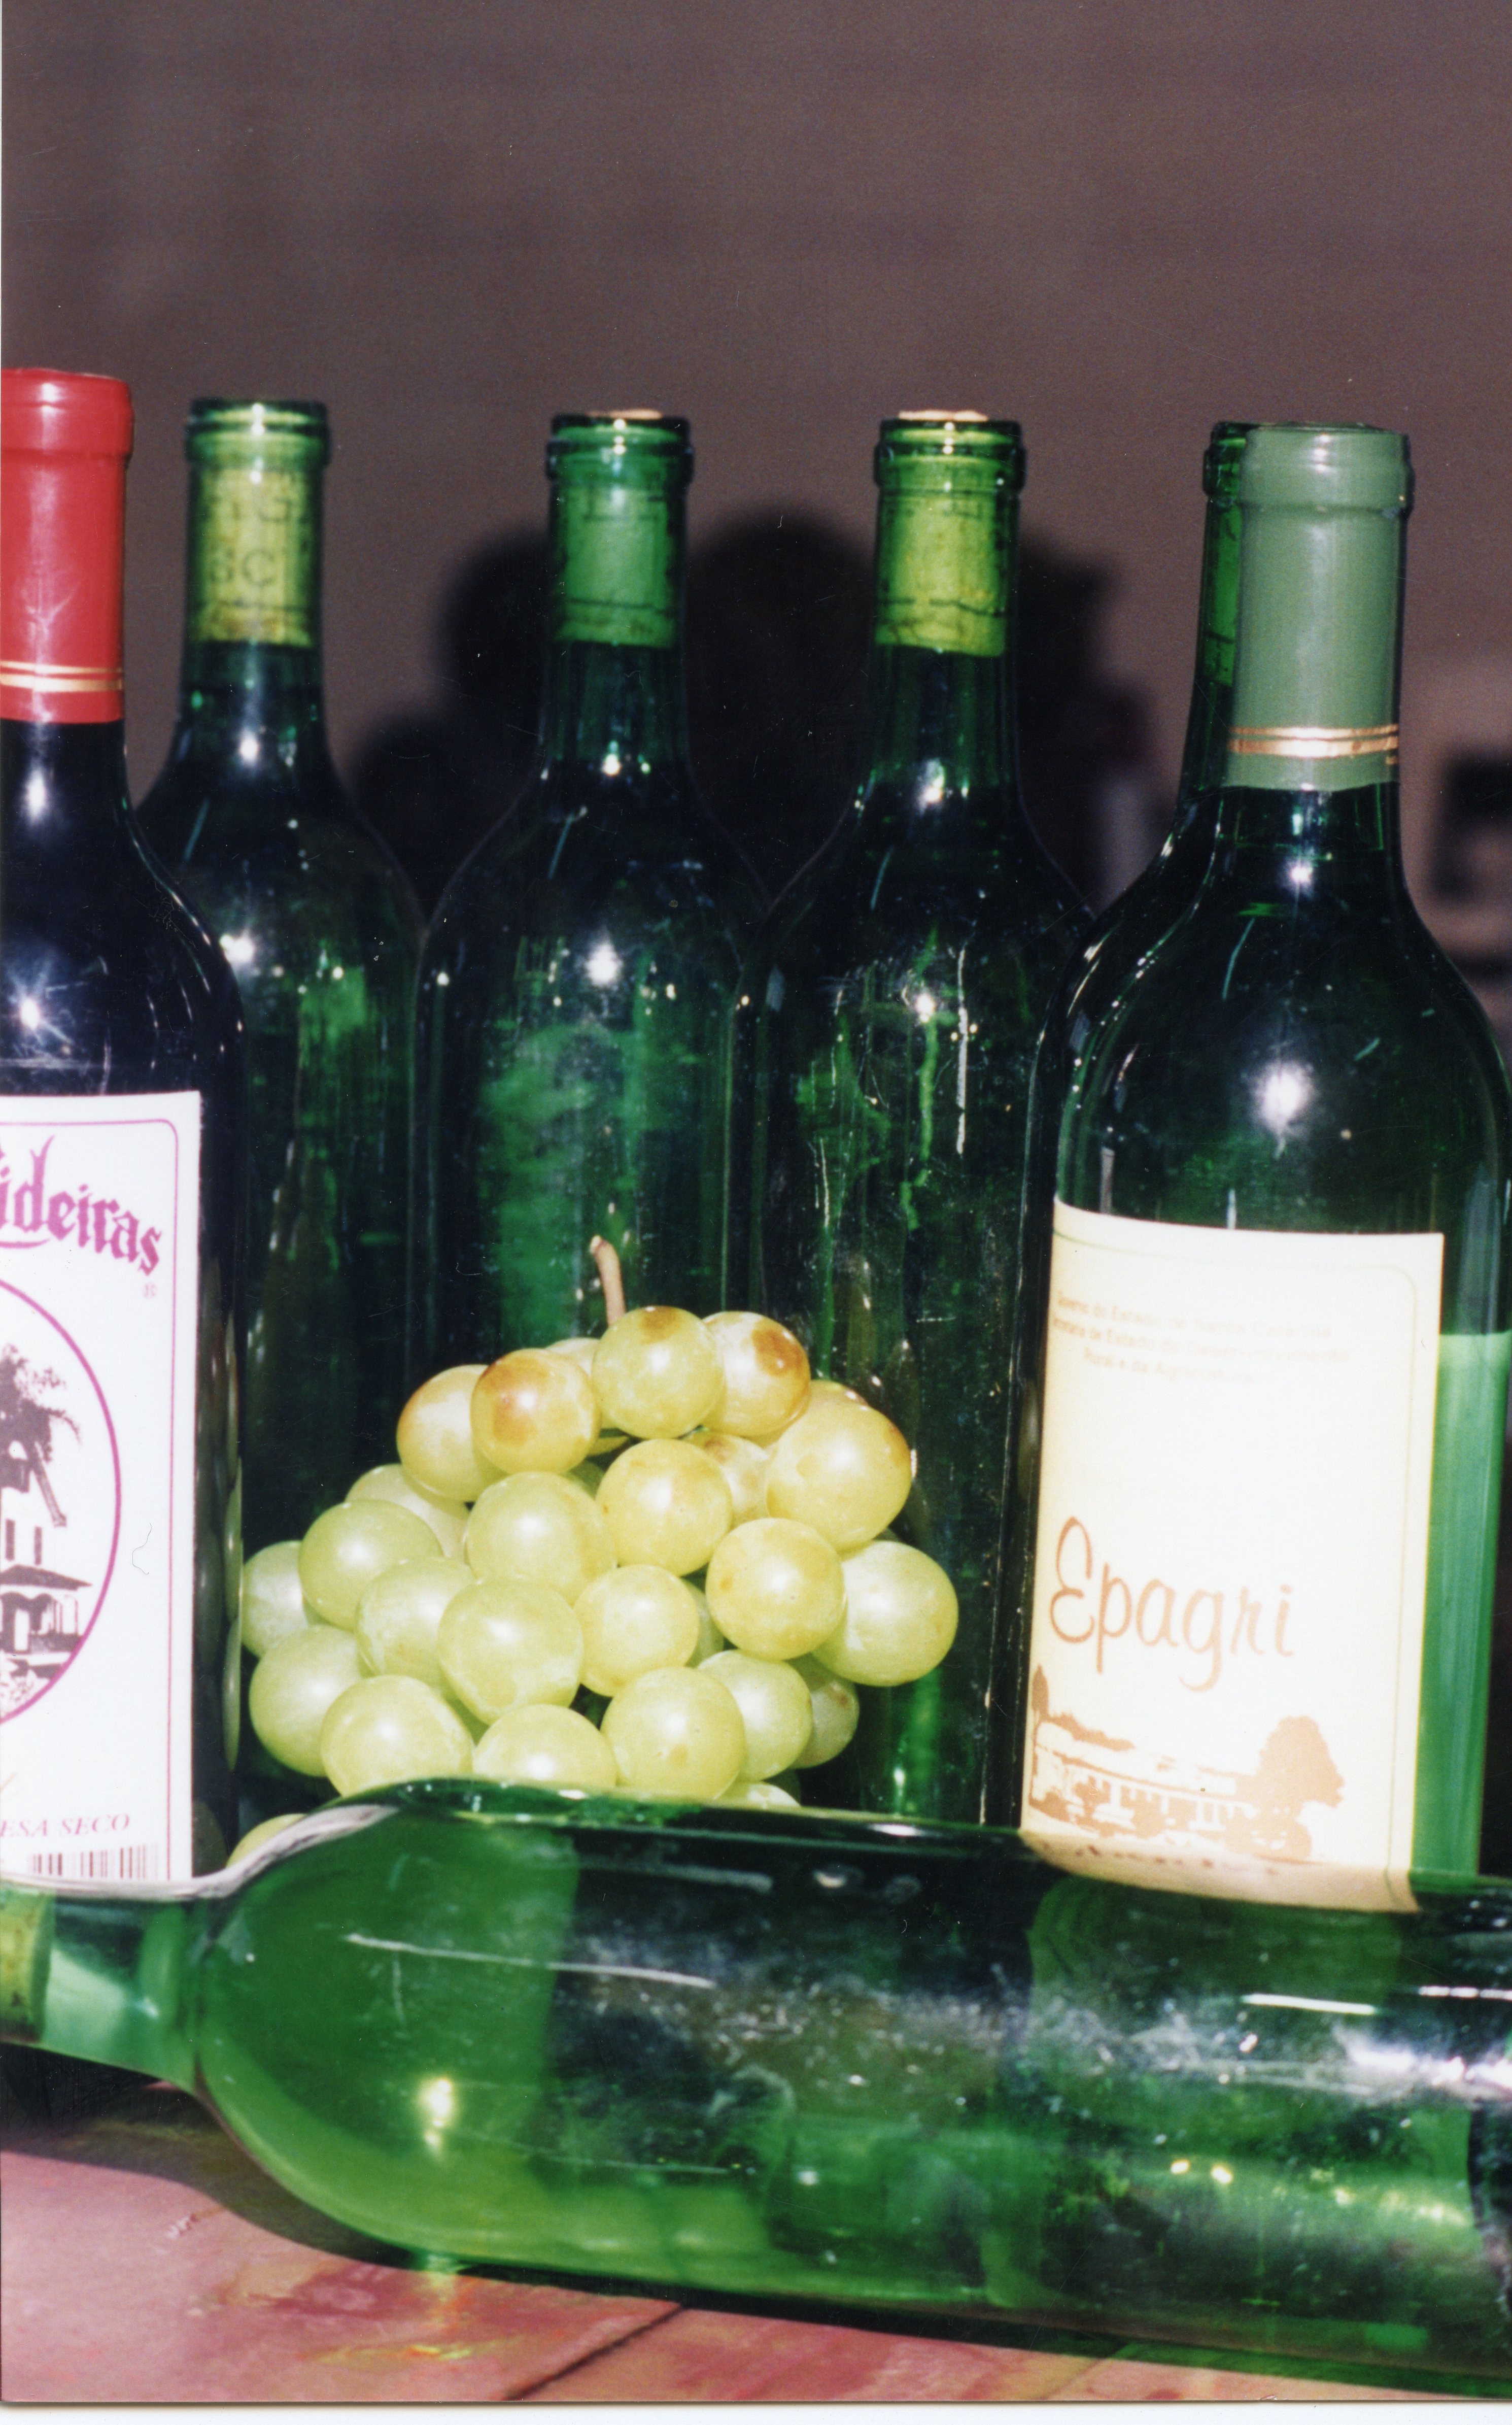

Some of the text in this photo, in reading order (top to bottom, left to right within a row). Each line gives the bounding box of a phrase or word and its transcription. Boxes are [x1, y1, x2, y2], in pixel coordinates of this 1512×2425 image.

[0, 1134, 162, 1275] ideiras
[1049, 1516, 1295, 1693] Epagri
[59, 1813, 130, 1836] SECO
